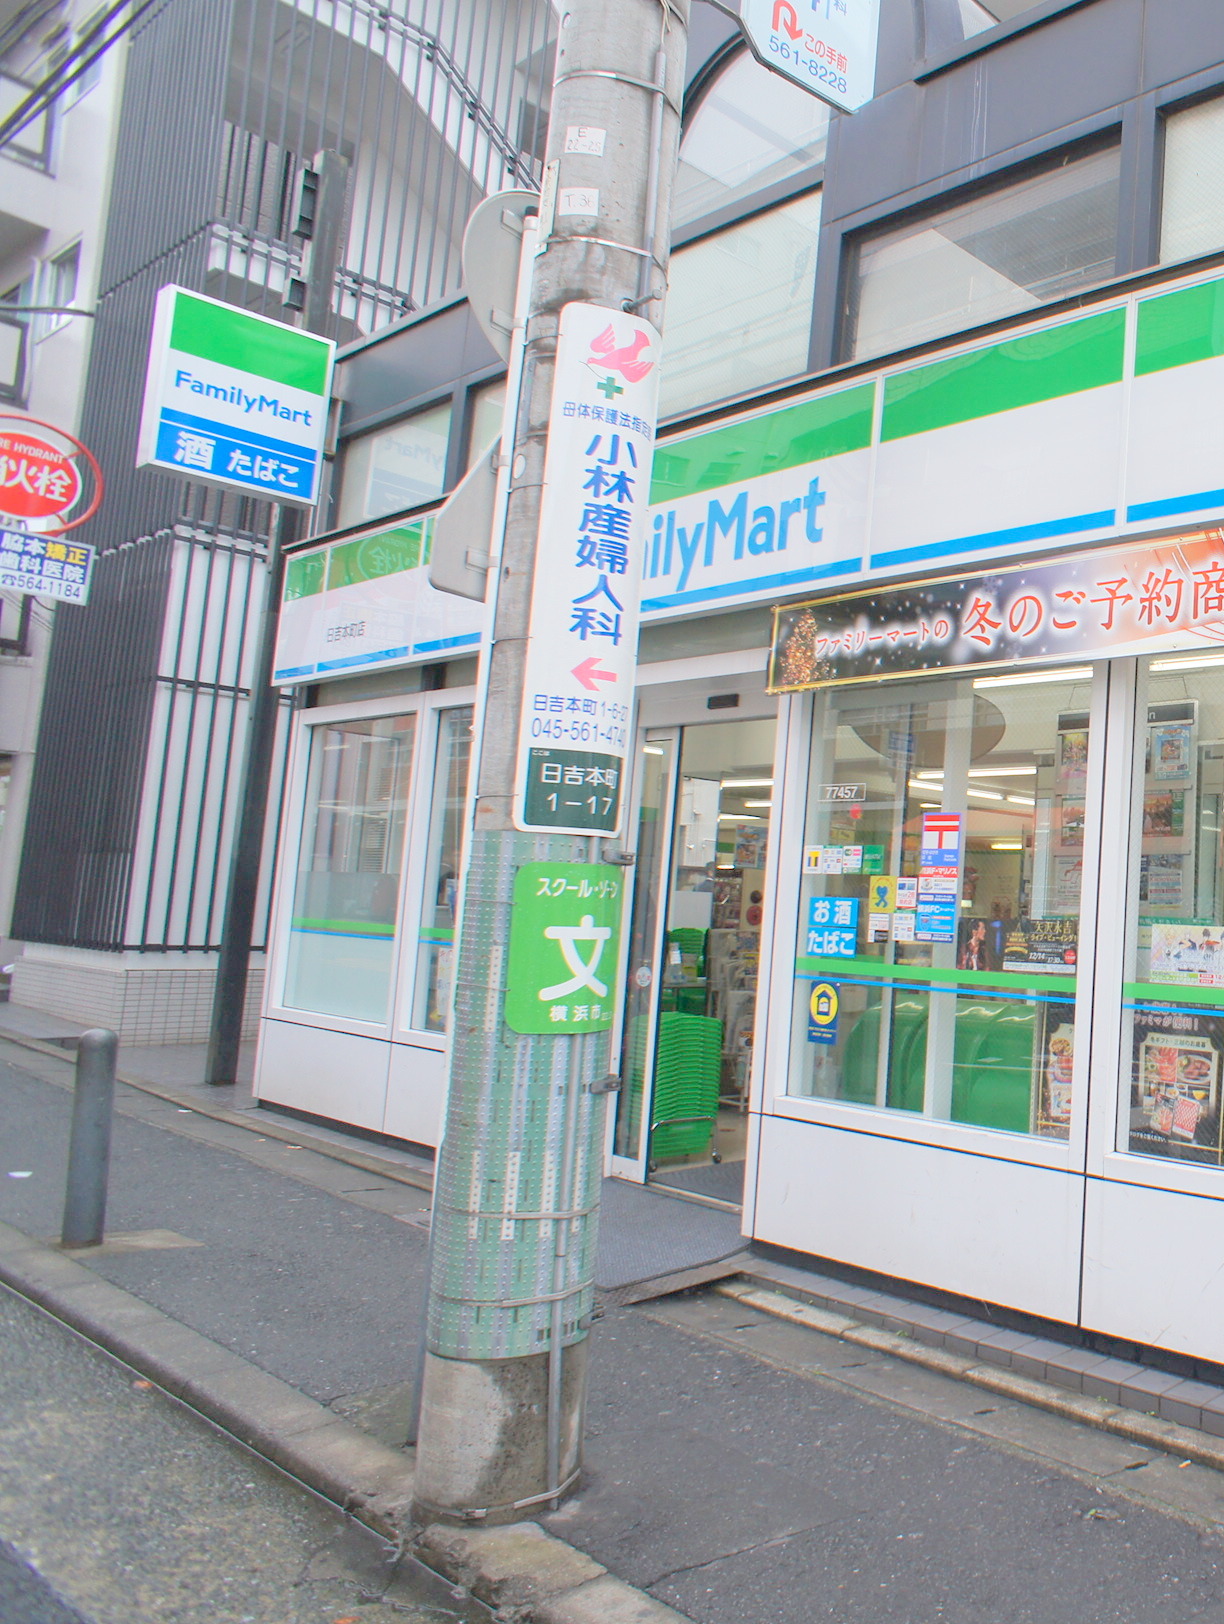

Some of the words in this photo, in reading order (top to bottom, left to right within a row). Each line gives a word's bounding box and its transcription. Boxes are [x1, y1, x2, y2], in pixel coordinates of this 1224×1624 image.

[768, 35, 847, 94] 561-8228
[804, 33, 848, 74] この手前
[174, 369, 313, 427] FamilyMart
[14, 442, 65, 465] HYDRANT
[173, 431, 216, 472] 酒
[227, 449, 299, 489] たばこ
[0, 455, 72, 503] 火栓
[569, 433, 639, 647] 小林産婦人科
[643, 475, 827, 593] ilyMart
[0, 552, 85, 585] 歯科医院
[17, 576, 81, 599] 564-1184
[327, 621, 367, 643] 日吉本町店
[816, 618, 949, 657] ファミリーマートの
[533, 694, 598, 716] 日吉本町
[541, 762, 619, 790] 日吉本町
[825, 786, 858, 799] 77457
[813, 900, 853, 925] お酒
[538, 914, 612, 1001] 文
[807, 929, 855, 955] たばこ
[550, 1004, 602, 1023] 横浜市
